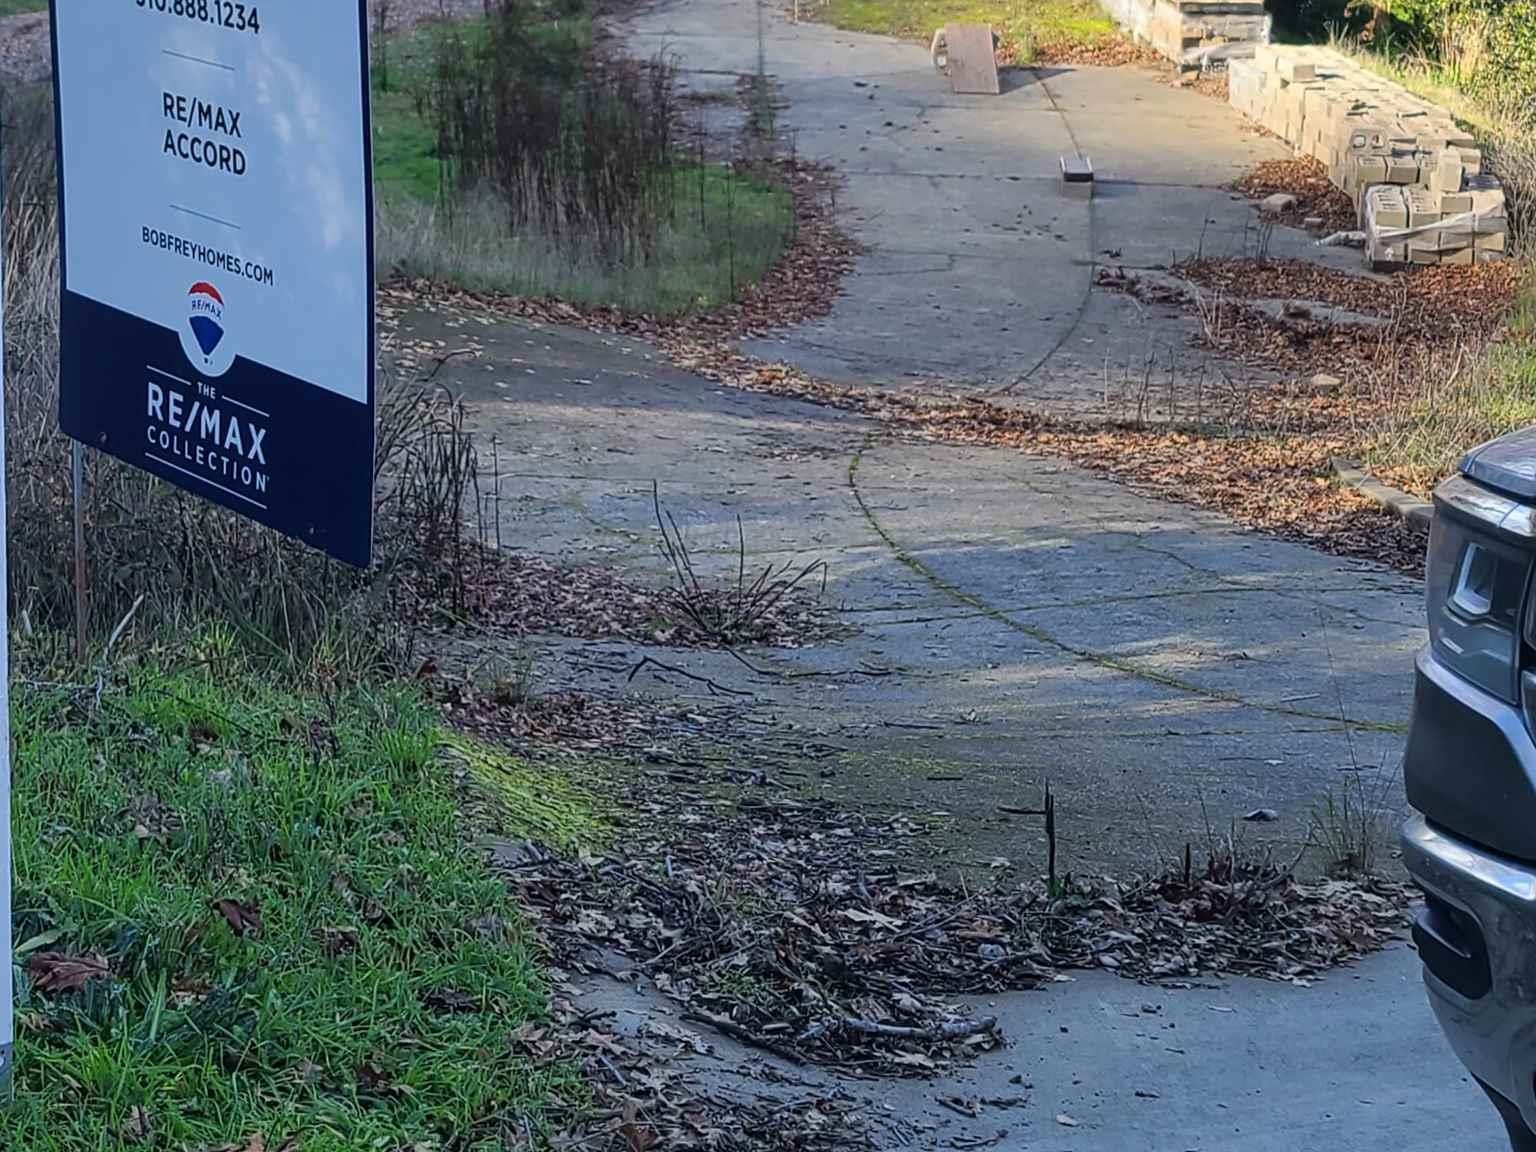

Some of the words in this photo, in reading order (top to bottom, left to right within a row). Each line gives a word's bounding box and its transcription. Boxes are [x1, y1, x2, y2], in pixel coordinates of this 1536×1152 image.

[163, 91, 242, 138] RE/MAX
[163, 129, 246, 175] ACCORD
[142, 226, 273, 286] BOBFREYHOMES.COM
[191, 299, 222, 320] RE/MAX
[197, 381, 216, 399] THE
[147, 382, 266, 465] RE/MAX
[147, 425, 267, 493] COLLECTION
